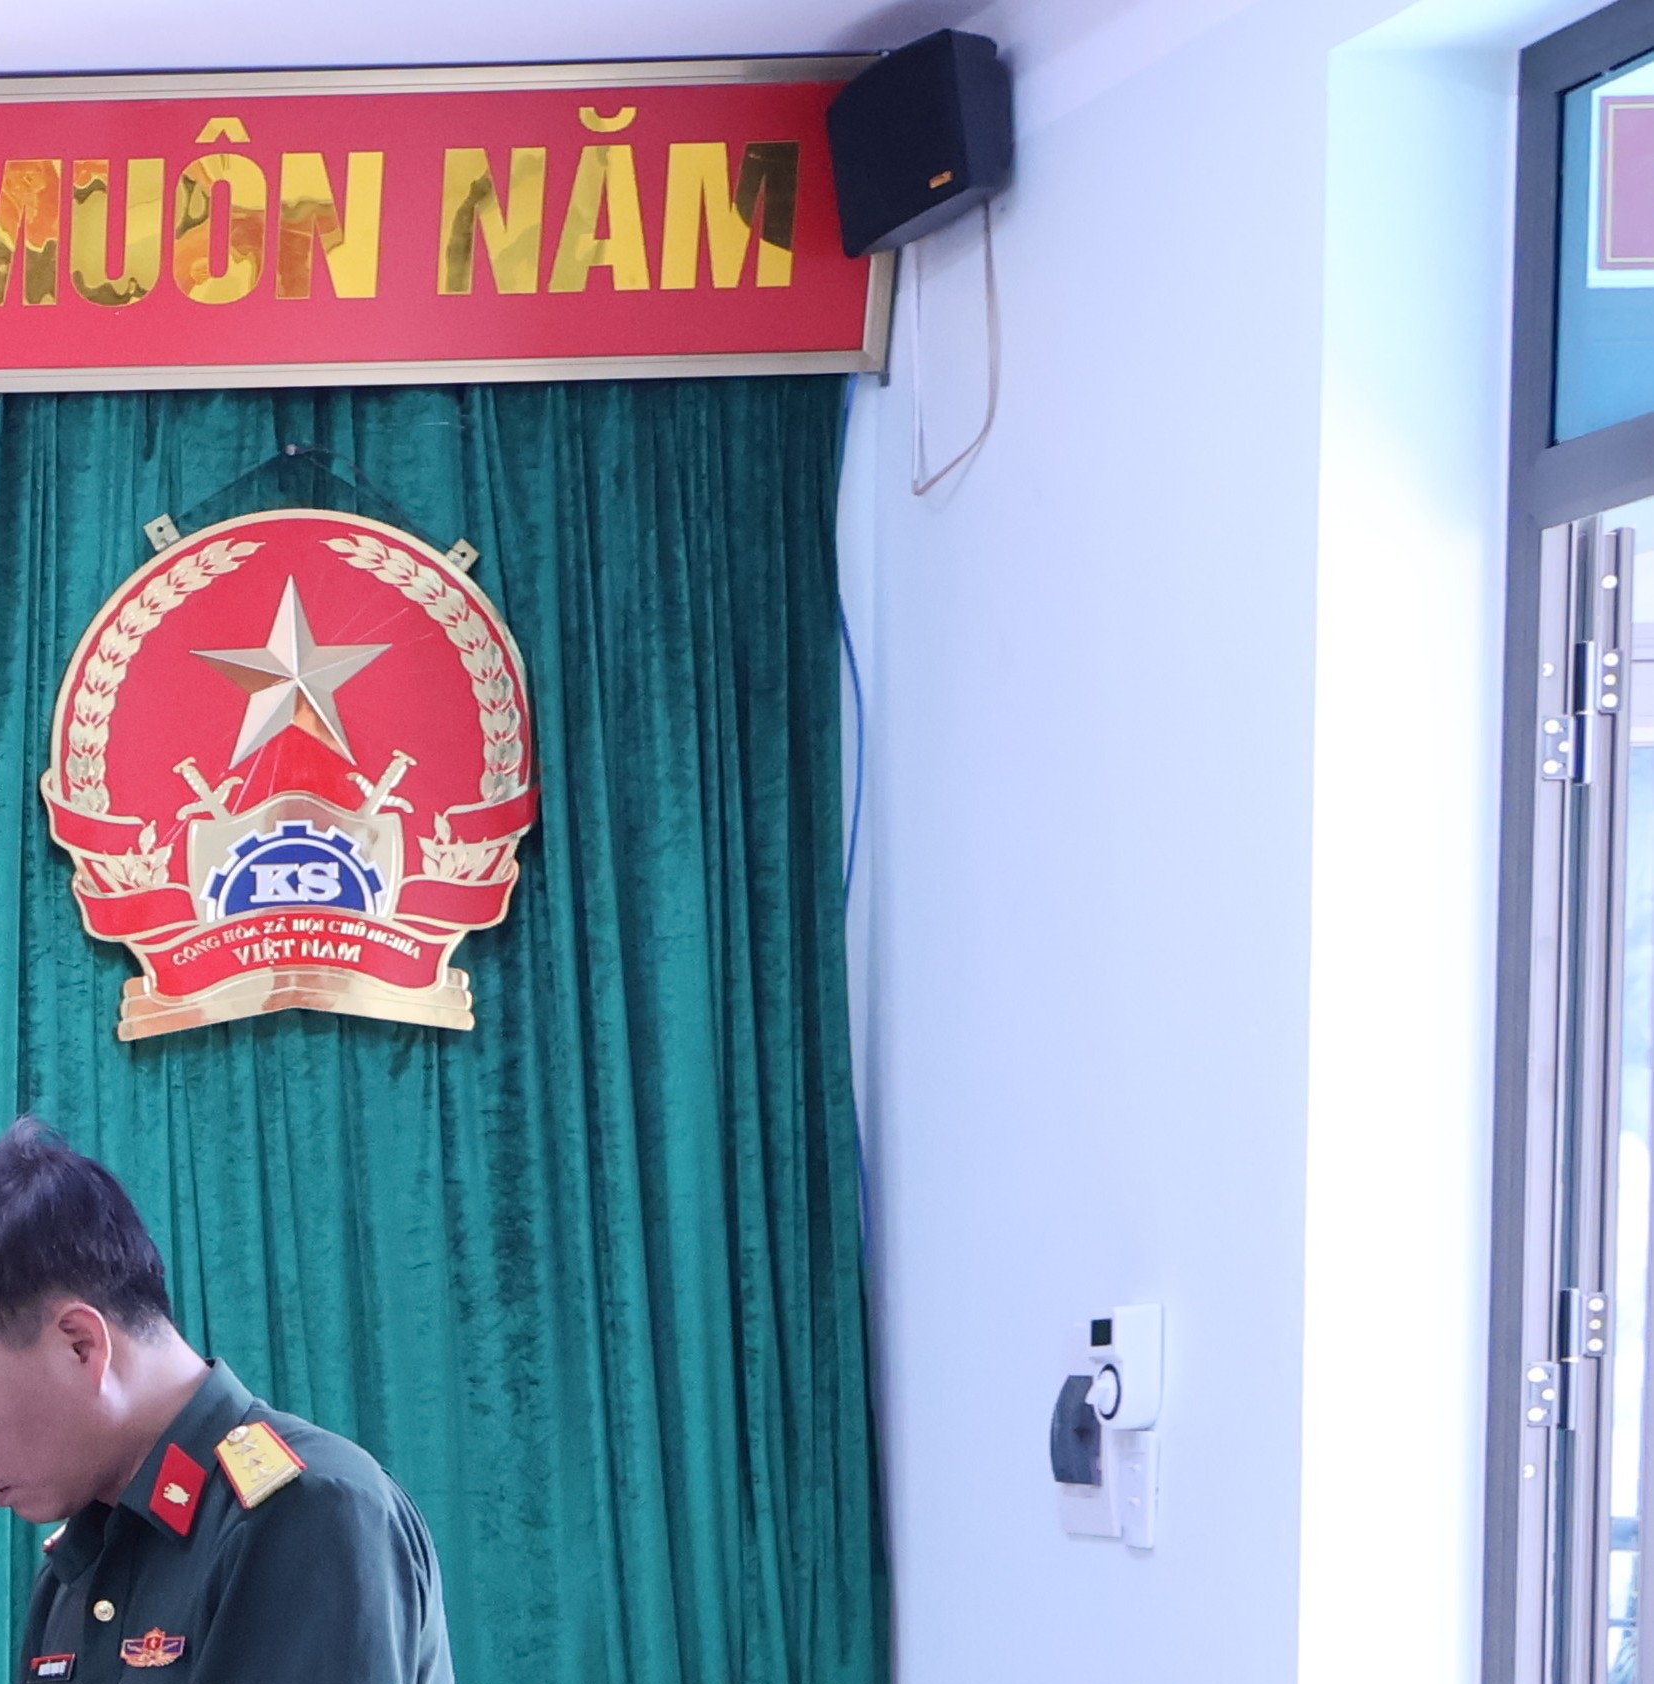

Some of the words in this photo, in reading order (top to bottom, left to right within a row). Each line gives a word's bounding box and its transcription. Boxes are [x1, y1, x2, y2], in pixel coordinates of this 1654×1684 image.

[434, 104, 799, 297] NĂM
[250, 861, 342, 903] KS
[232, 936, 296, 966] VIỆT
[301, 938, 362, 963] NAM
